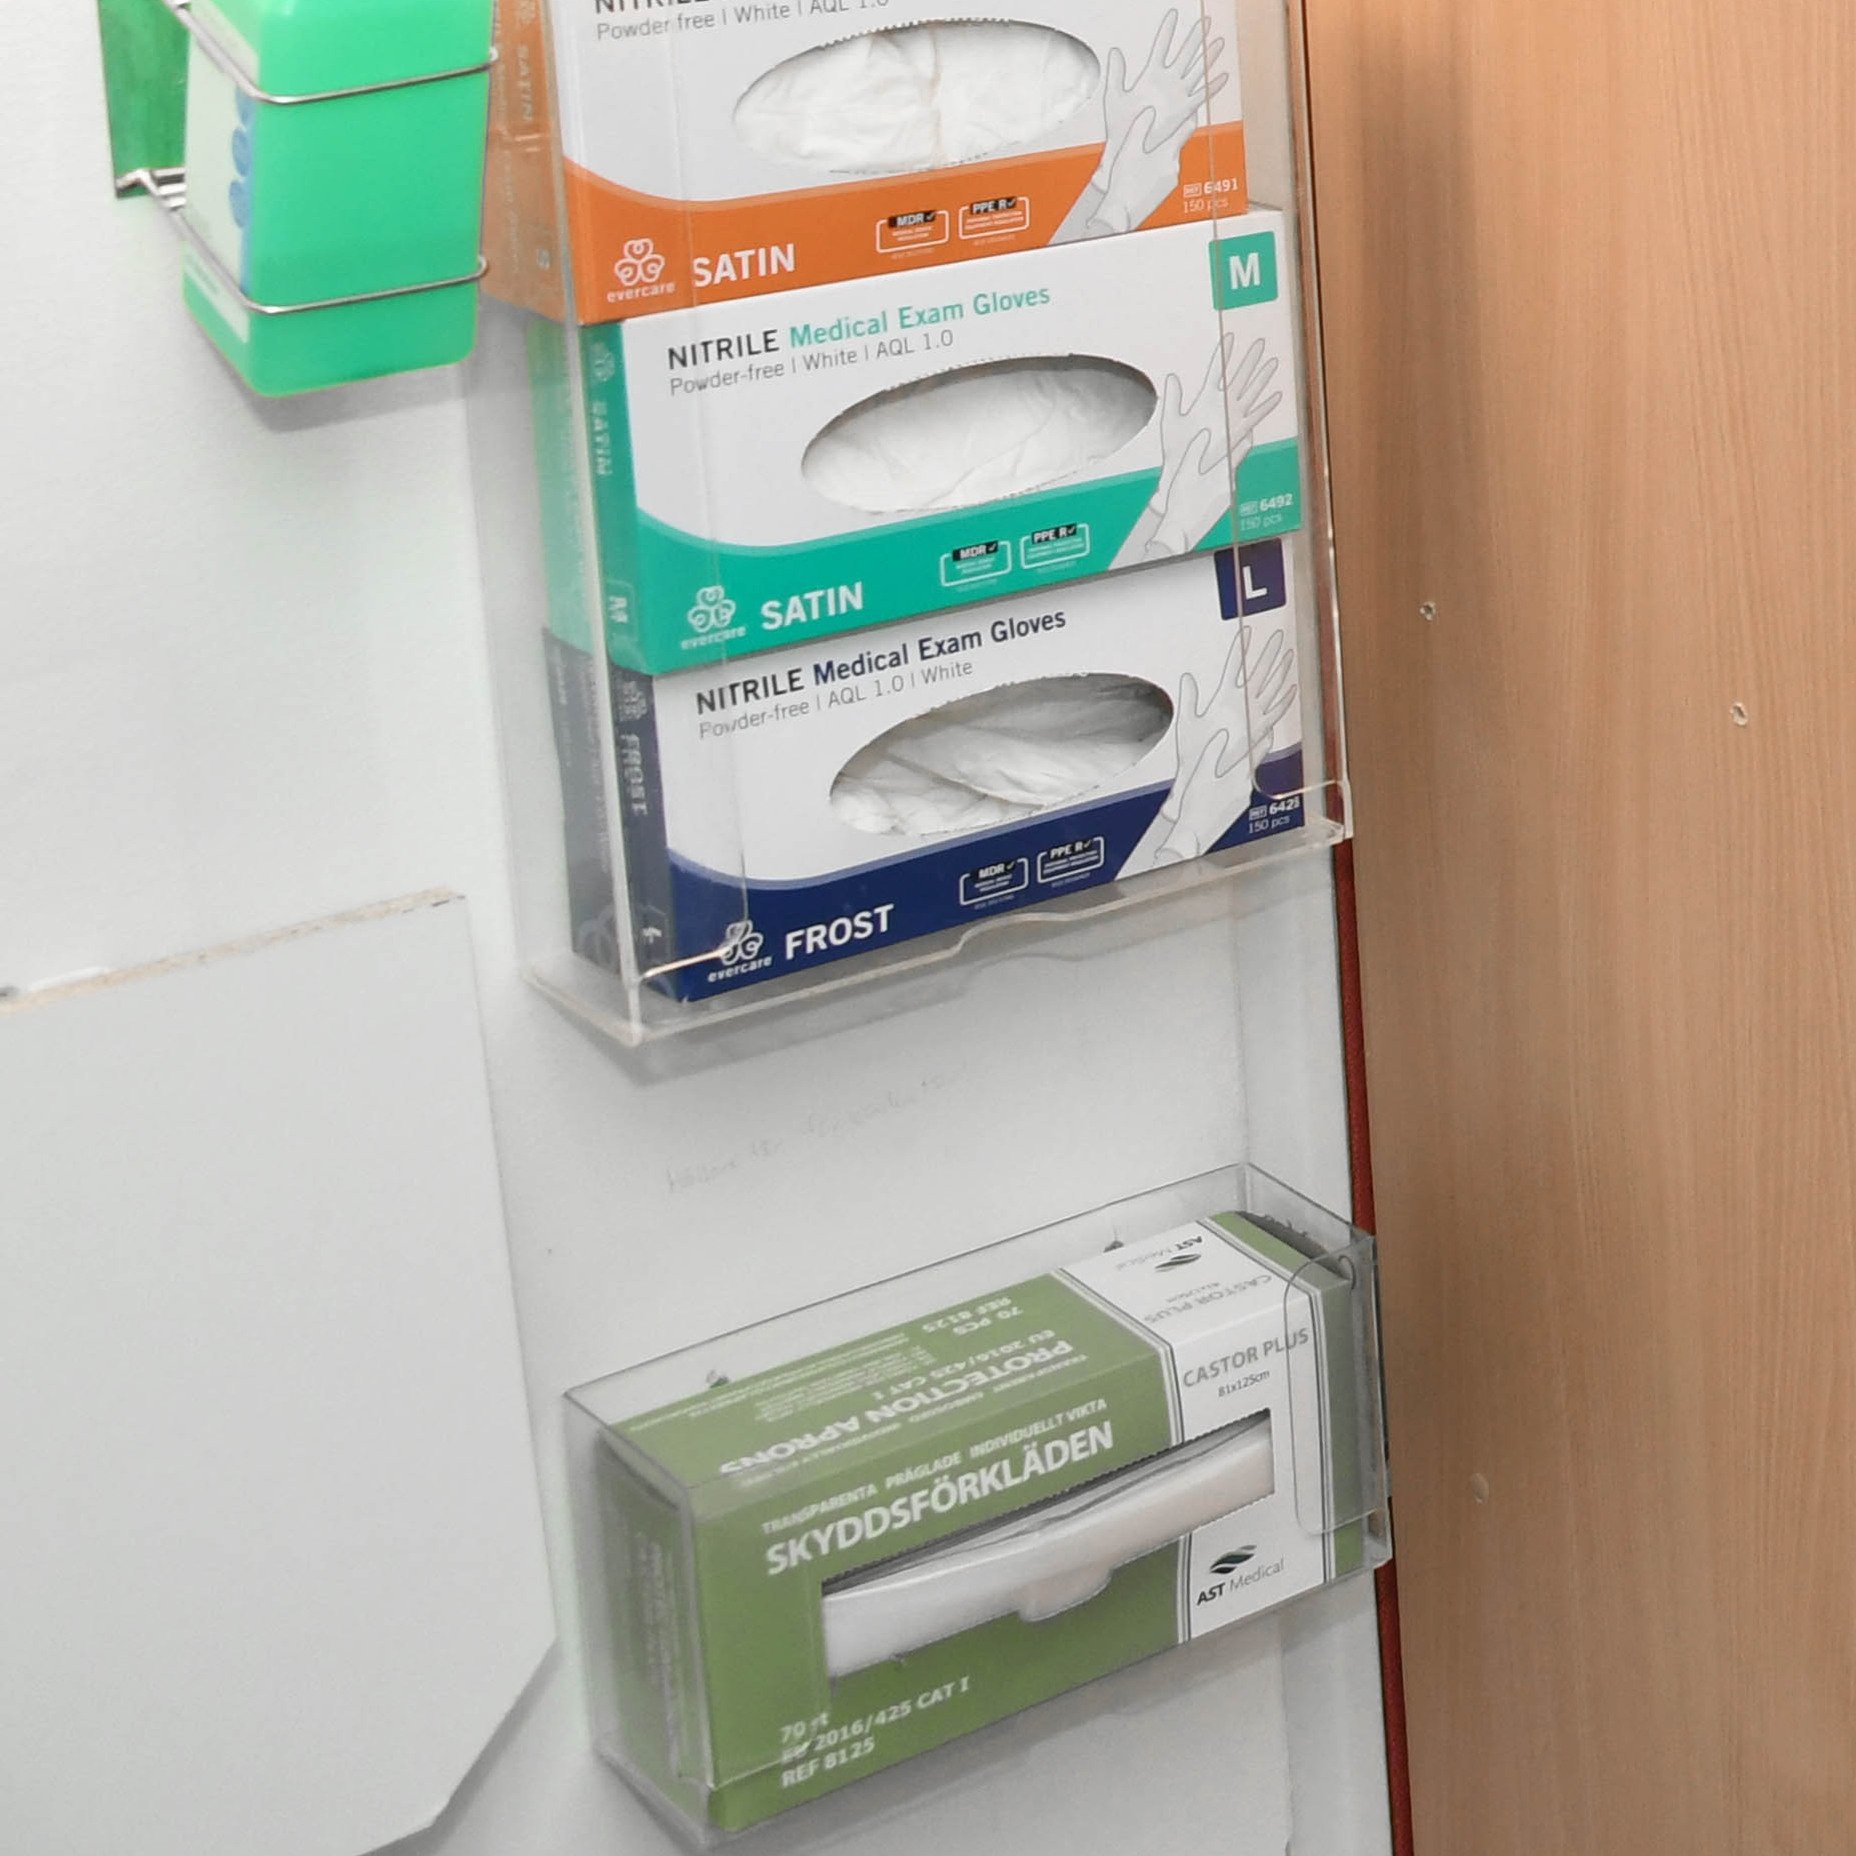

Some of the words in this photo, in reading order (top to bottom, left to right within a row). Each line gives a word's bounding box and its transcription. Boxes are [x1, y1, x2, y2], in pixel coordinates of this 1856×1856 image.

[733, 1, 791, 25] White
[692, 242, 796, 288] SATIN
[1228, 251, 1262, 290] M
[606, 281, 676, 304] evercare
[668, 328, 781, 370] NITRILE
[788, 310, 889, 349] Medical
[898, 303, 965, 330] Exam
[972, 286, 1051, 316] Gloves
[669, 361, 786, 397] Powder-free
[803, 348, 859, 372] White
[875, 336, 916, 359] AQL
[922, 328, 955, 351] 1.0
[760, 581, 865, 631] SATIN
[1242, 565, 1269, 601] L
[695, 667, 806, 716] NITRILE
[812, 642, 911, 687] Medical
[917, 629, 984, 662] Exam
[989, 609, 1068, 645] Gloves
[698, 698, 811, 740] Powder-free
[826, 686, 868, 709] AQL
[873, 675, 905, 698] 1.0
[922, 658, 975, 686] White
[1049, 843, 1074, 860] PPE
[1249, 818, 1270, 834] 150
[977, 861, 1006, 880] MDR
[783, 902, 896, 962] FROST
[706, 954, 775, 984] evercare
[864, 1339, 1075, 1424] PROTECTION
[1182, 1344, 1261, 1388] CASTOR
[1261, 1326, 1311, 1358] PLUS
[884, 1450, 963, 1491] PRÄGLADE
[969, 1411, 1066, 1460] INDIVIDUELLT
[1065, 1396, 1108, 1421] VIKTA
[764, 1420, 1115, 1577] SKYDDSFÖRKLÄDEN
[1196, 1582, 1227, 1607] AST
[1228, 1556, 1286, 1592] Medical
[780, 1720, 807, 1745] 70
[813, 1698, 913, 1751] 2016/425
[916, 1681, 956, 1710] CAT
[959, 1675, 971, 1694] I
[781, 1757, 821, 1789] REF
[822, 1735, 876, 1771] 8125
